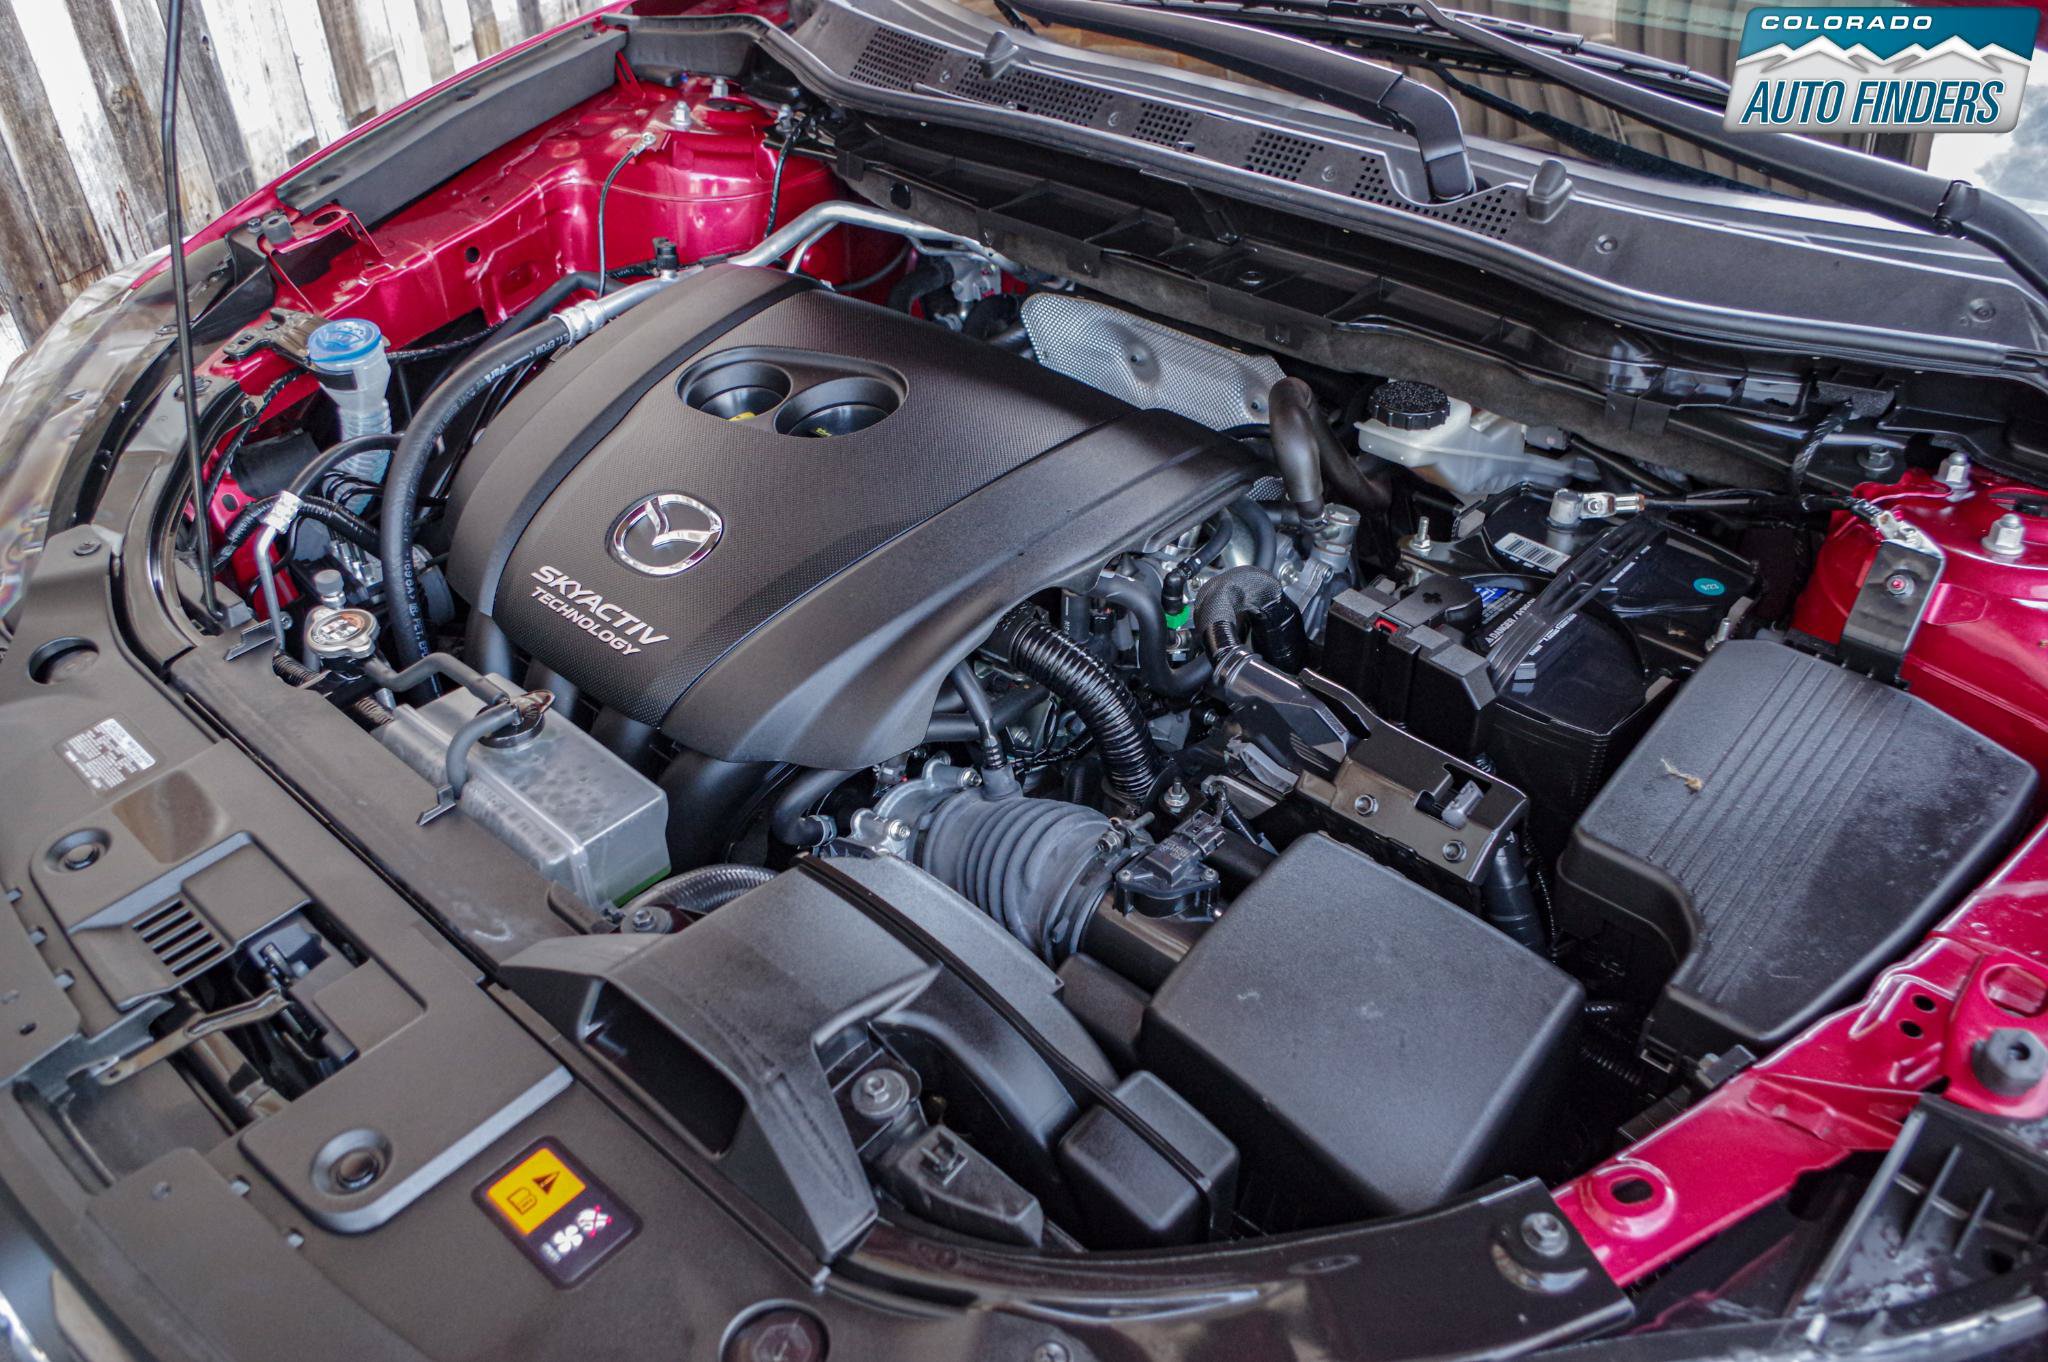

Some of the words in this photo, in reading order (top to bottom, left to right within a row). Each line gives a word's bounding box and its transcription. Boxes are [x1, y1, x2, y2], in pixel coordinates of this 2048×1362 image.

[531, 565, 669, 646] SKYACTIV
[531, 586, 642, 656] TECHNOLOGY
[1489, 617, 1516, 640] DANGER
